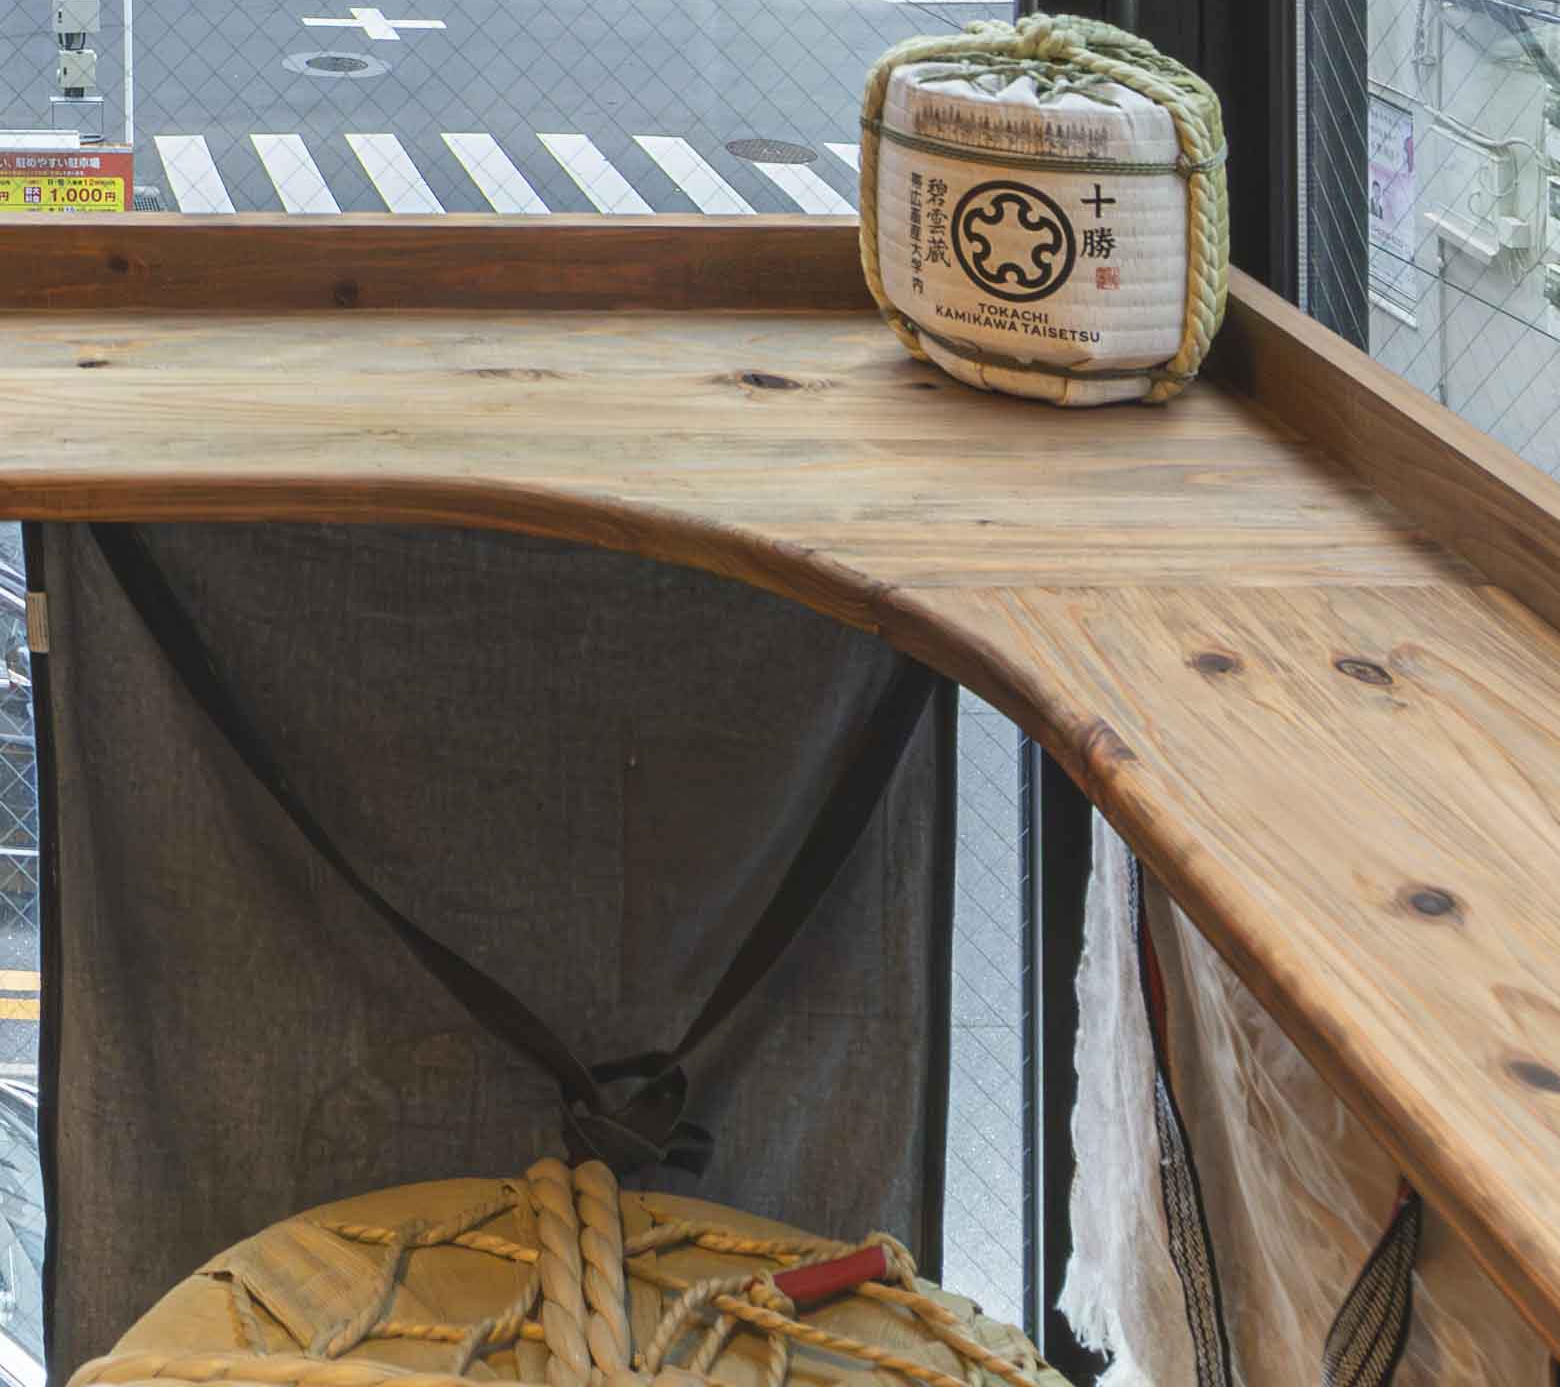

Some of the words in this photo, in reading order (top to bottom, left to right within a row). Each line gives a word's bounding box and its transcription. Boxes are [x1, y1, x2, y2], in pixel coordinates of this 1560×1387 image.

[1079, 183, 1117, 260] 十勝
[936, 305, 1018, 332] KAMIKAWA
[1021, 323, 1100, 343] TAISETSU
[978, 303, 1049, 325] TOKACHI
